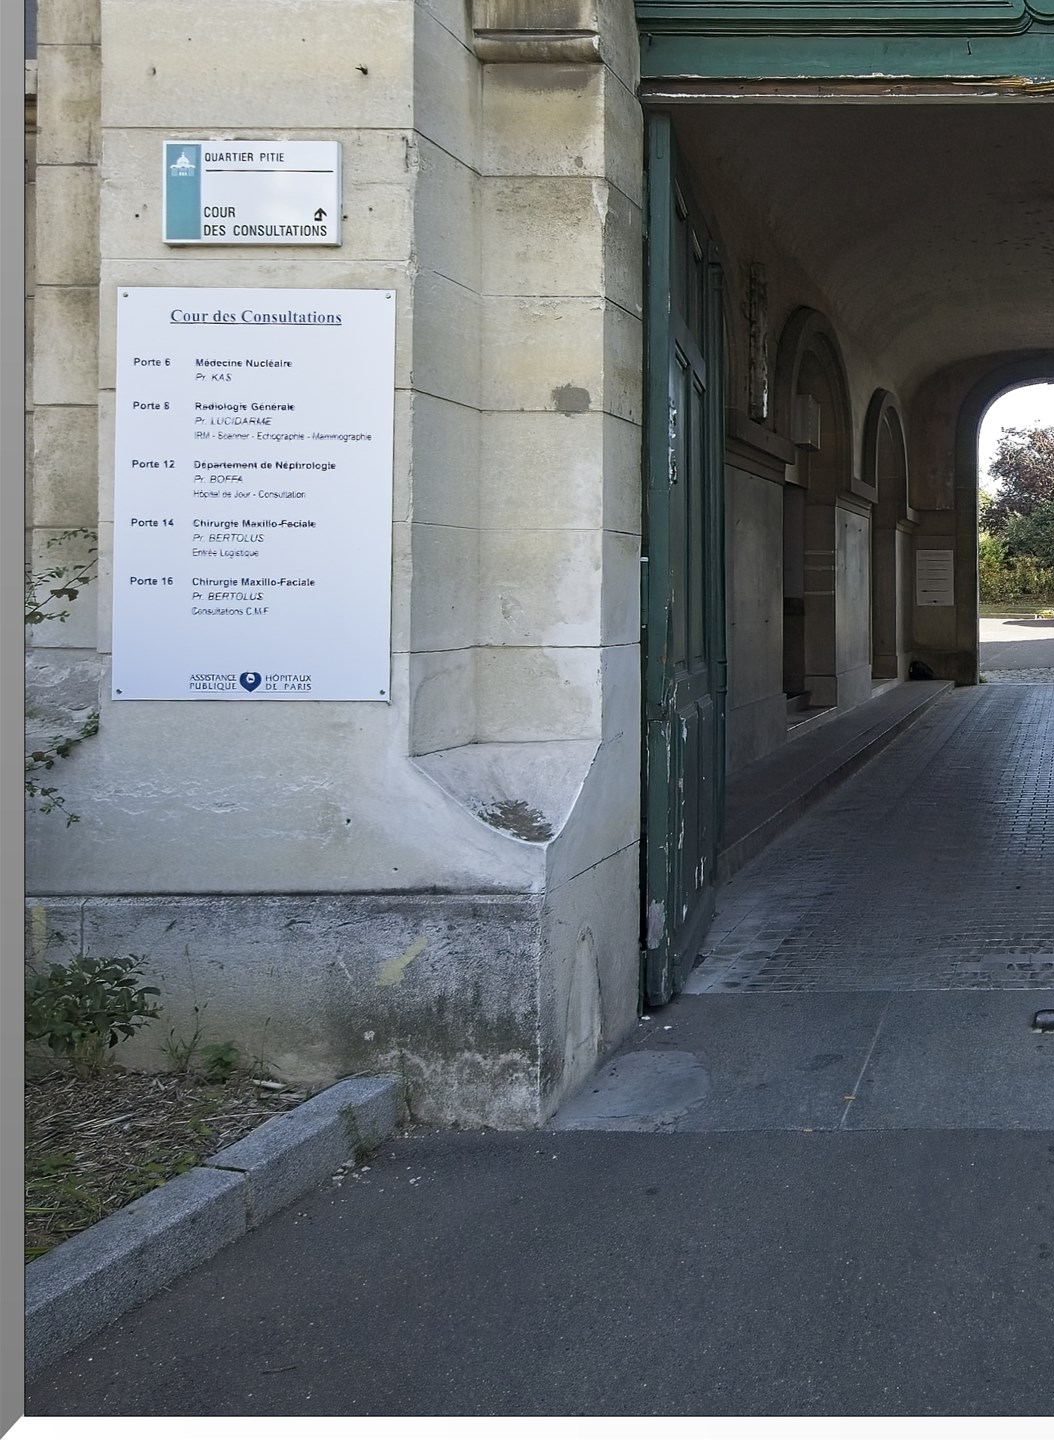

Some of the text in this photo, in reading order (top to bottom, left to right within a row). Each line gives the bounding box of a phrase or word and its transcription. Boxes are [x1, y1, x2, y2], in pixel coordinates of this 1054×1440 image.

[204, 152, 285, 162] QUARTIER PITIE
[203, 206, 236, 218] COUR
[203, 224, 328, 237] DES CONSULTATIONS
[170, 309, 342, 324] Cour des Consultations
[133, 357, 171, 367] Porte 6
[195, 358, 293, 368] Médecine Nucléaire
[211, 373, 232, 383] KAS
[133, 401, 170, 411] Porte 8
[195, 402, 296, 413] Radiologie Générale
[210, 417, 272, 427] LUCIDARME
[194, 431, 210, 440] IRM
[218, 431, 250, 441] Scanner
[312, 432, 372, 443] Mammographie
[132, 460, 175, 469] Porte 12
[193, 460, 336, 471] Département de Néphrologie
[209, 474, 244, 484] BOFFA
[222, 489, 232, 499] de
[234, 490, 251, 499] Jour
[258, 489, 306, 499] Consultation
[130, 518, 174, 528] Porte 14
[193, 518, 316, 530] Chirurgie Maxillo-Faciale
[208, 533, 265, 543] BERTOLUS
[192, 548, 259, 559] Entrée Logistique
[130, 576, 174, 586] Porte 16
[192, 577, 316, 588] Chirurgie Maxillo-Faciale
[207, 592, 264, 602] BERTOLUS
[191, 607, 243, 616] Consultations
[189, 674, 237, 682] ASSISTANCE
[189, 682, 237, 691] PUBLIQUE
[265, 683, 312, 691] DE PARIS
